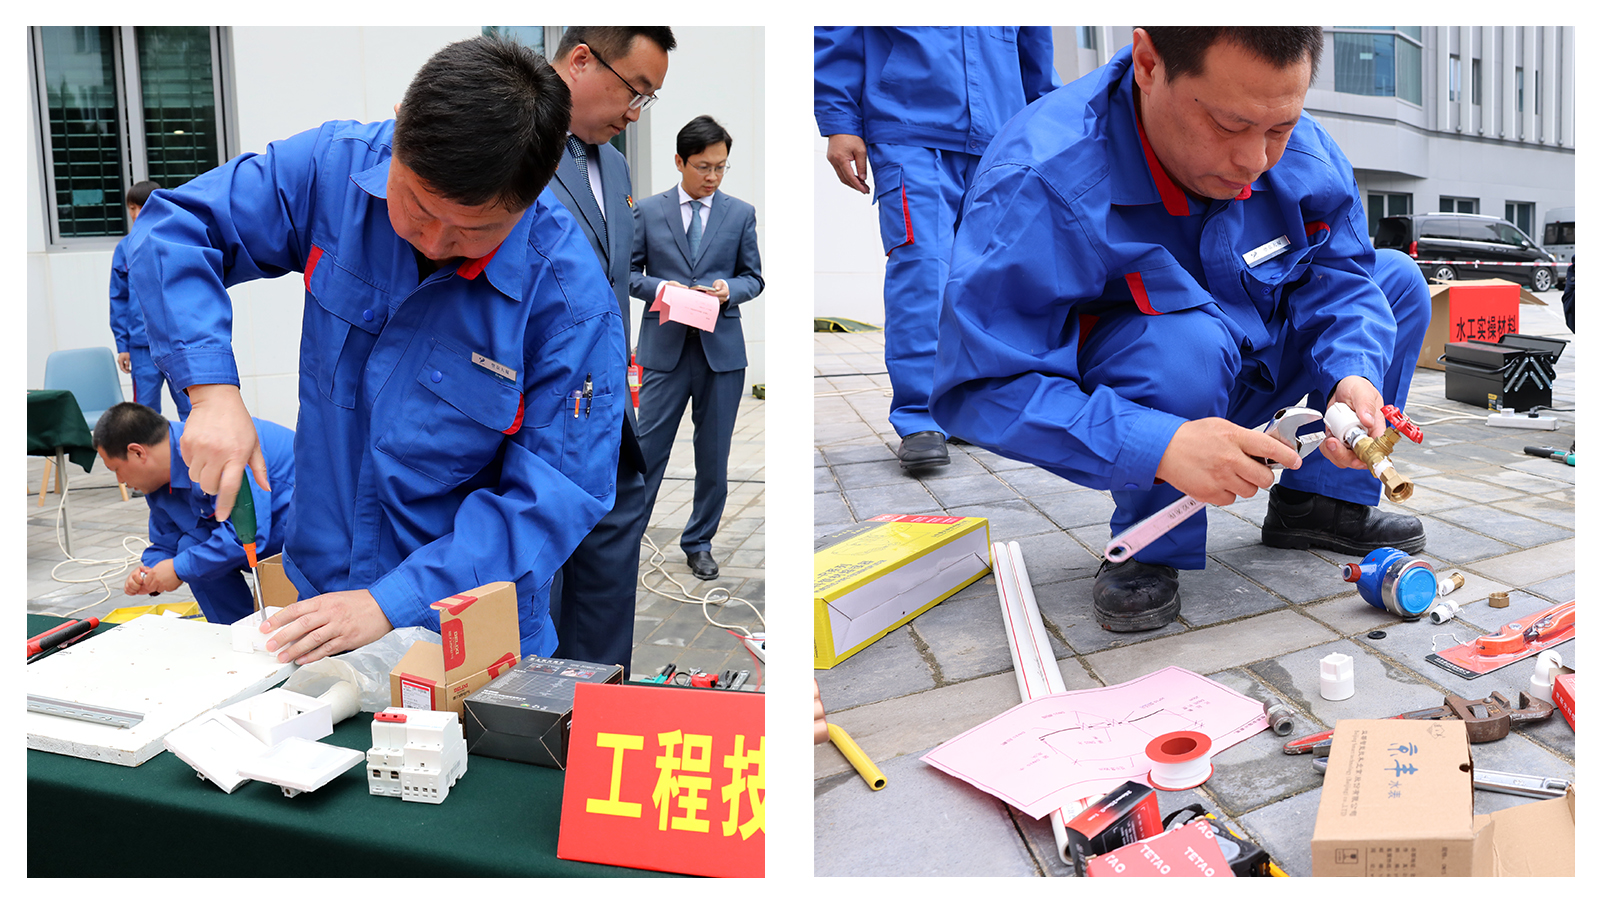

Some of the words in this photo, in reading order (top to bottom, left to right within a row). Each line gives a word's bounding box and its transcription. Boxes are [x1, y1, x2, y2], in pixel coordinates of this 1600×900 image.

[1456, 315, 1516, 341] 水工实操材料
[585, 729, 765, 841] 工程技
[1139, 844, 1171, 875] TETAO
[1183, 846, 1215, 877] TETAO
